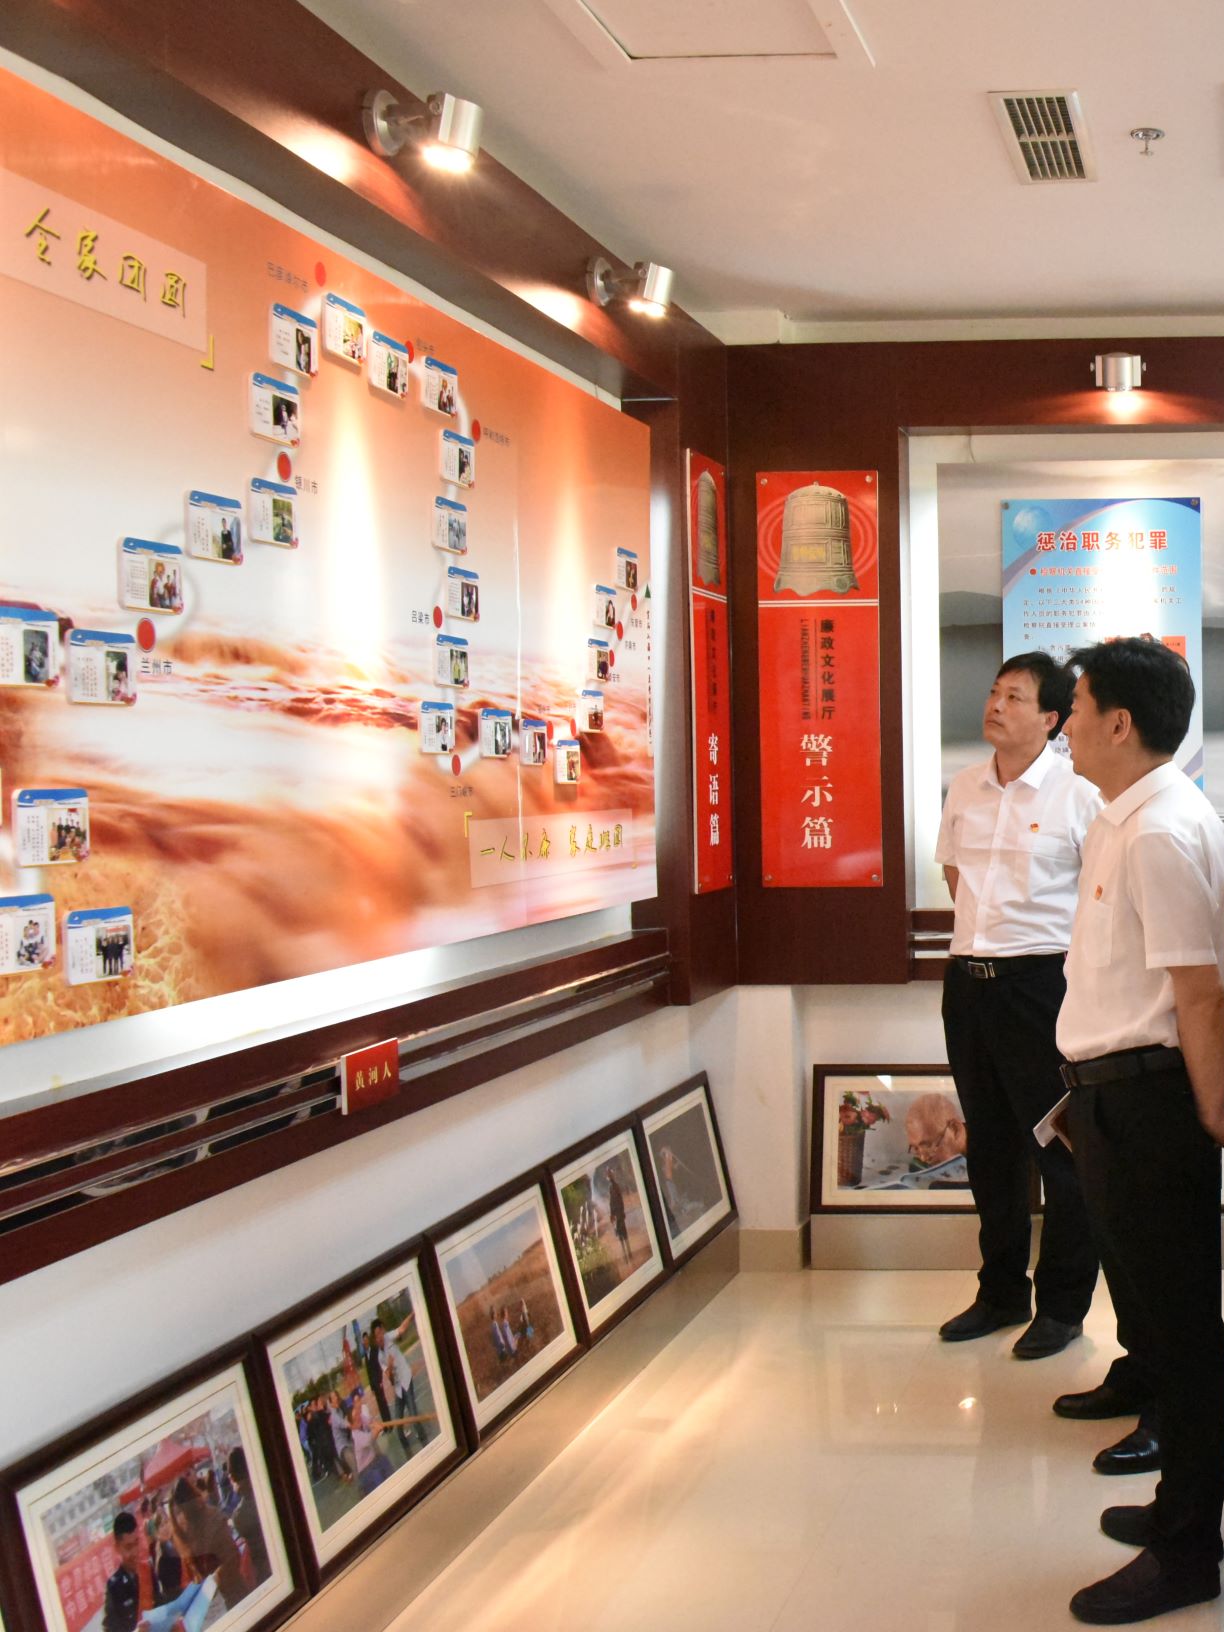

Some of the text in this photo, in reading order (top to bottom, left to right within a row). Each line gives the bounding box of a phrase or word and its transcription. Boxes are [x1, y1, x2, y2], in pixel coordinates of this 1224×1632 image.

[25, 207, 187, 320] 全家团圆
[1036, 530, 1168, 552] 惩治职务犯罪
[140, 656, 174, 676] 兰州市
[800, 732, 834, 851] 警示篇
[354, 1060, 393, 1092] 黄河人
